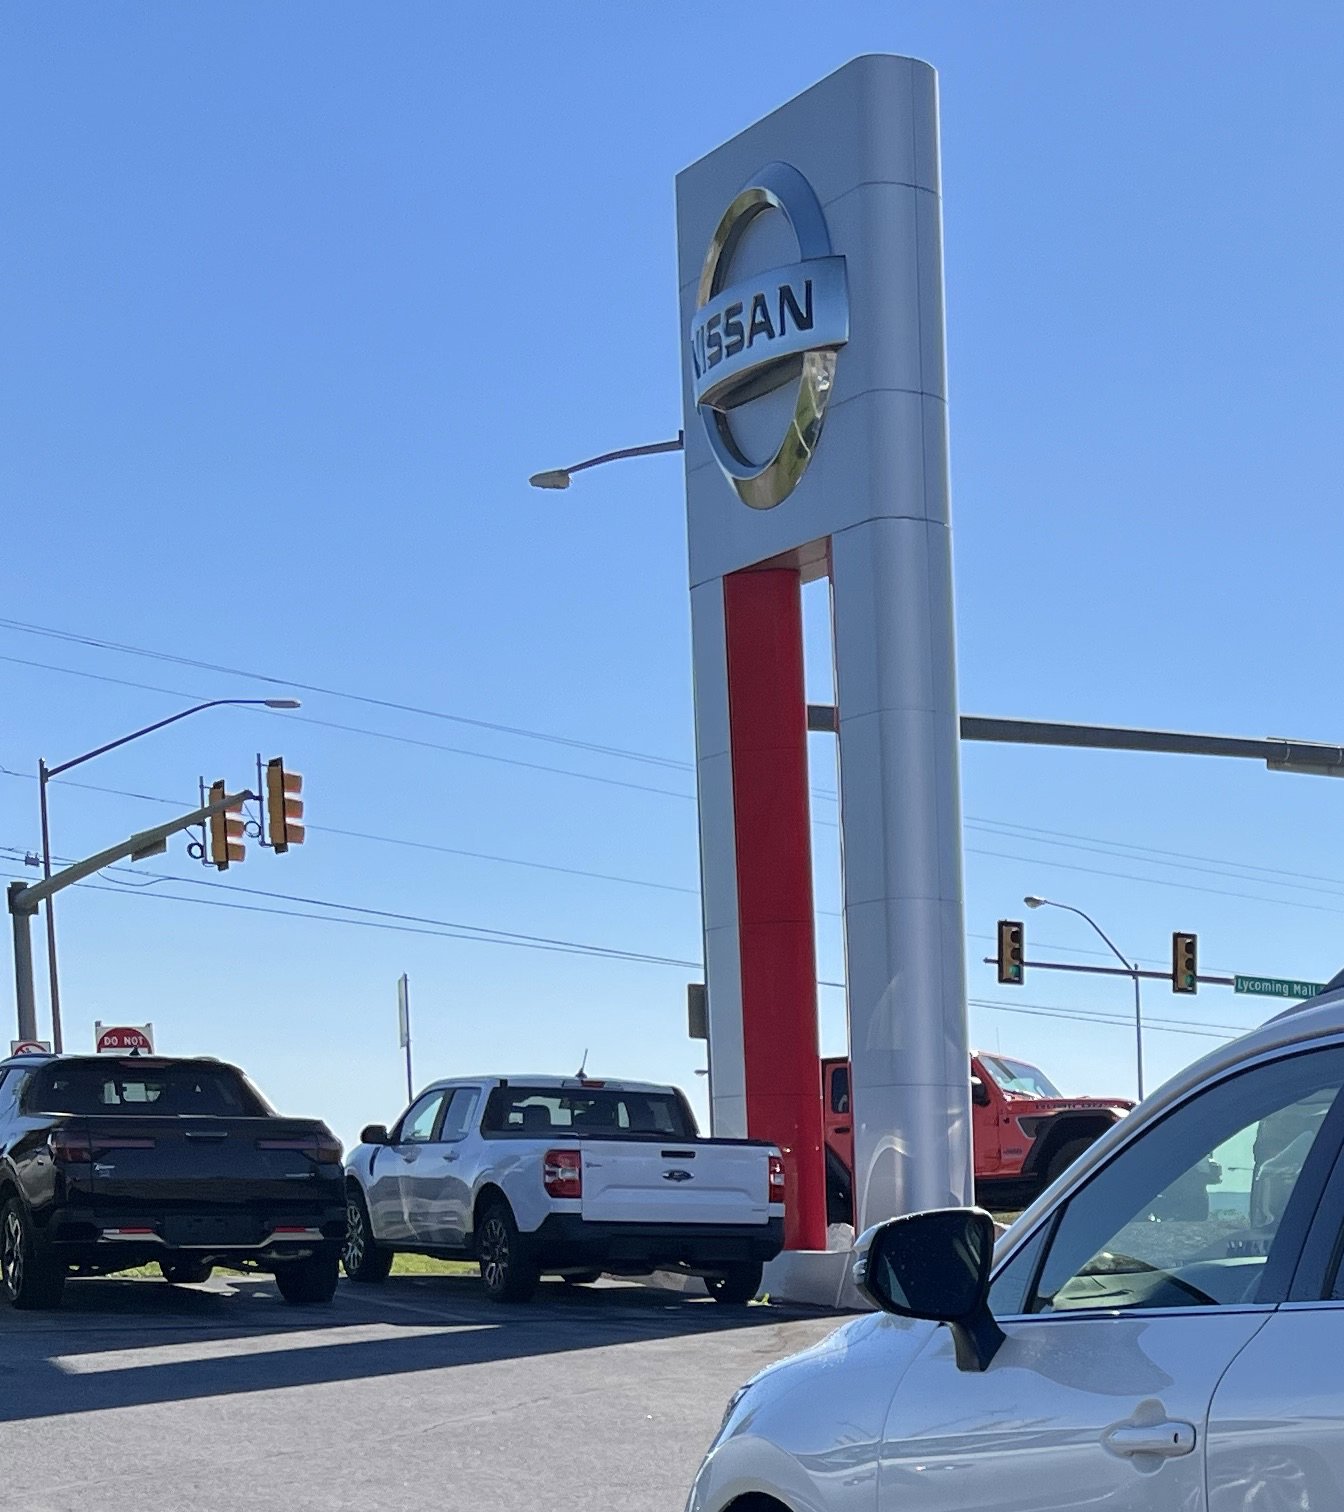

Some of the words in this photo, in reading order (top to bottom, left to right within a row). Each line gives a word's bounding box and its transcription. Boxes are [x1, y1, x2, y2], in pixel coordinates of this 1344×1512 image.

[690, 280, 814, 380] NISSAN
[1237, 978, 1289, 997] Lycoming
[1293, 983, 1316, 997] Mall
[104, 1036, 118, 1046] DO
[124, 1036, 144, 1046] NOT
